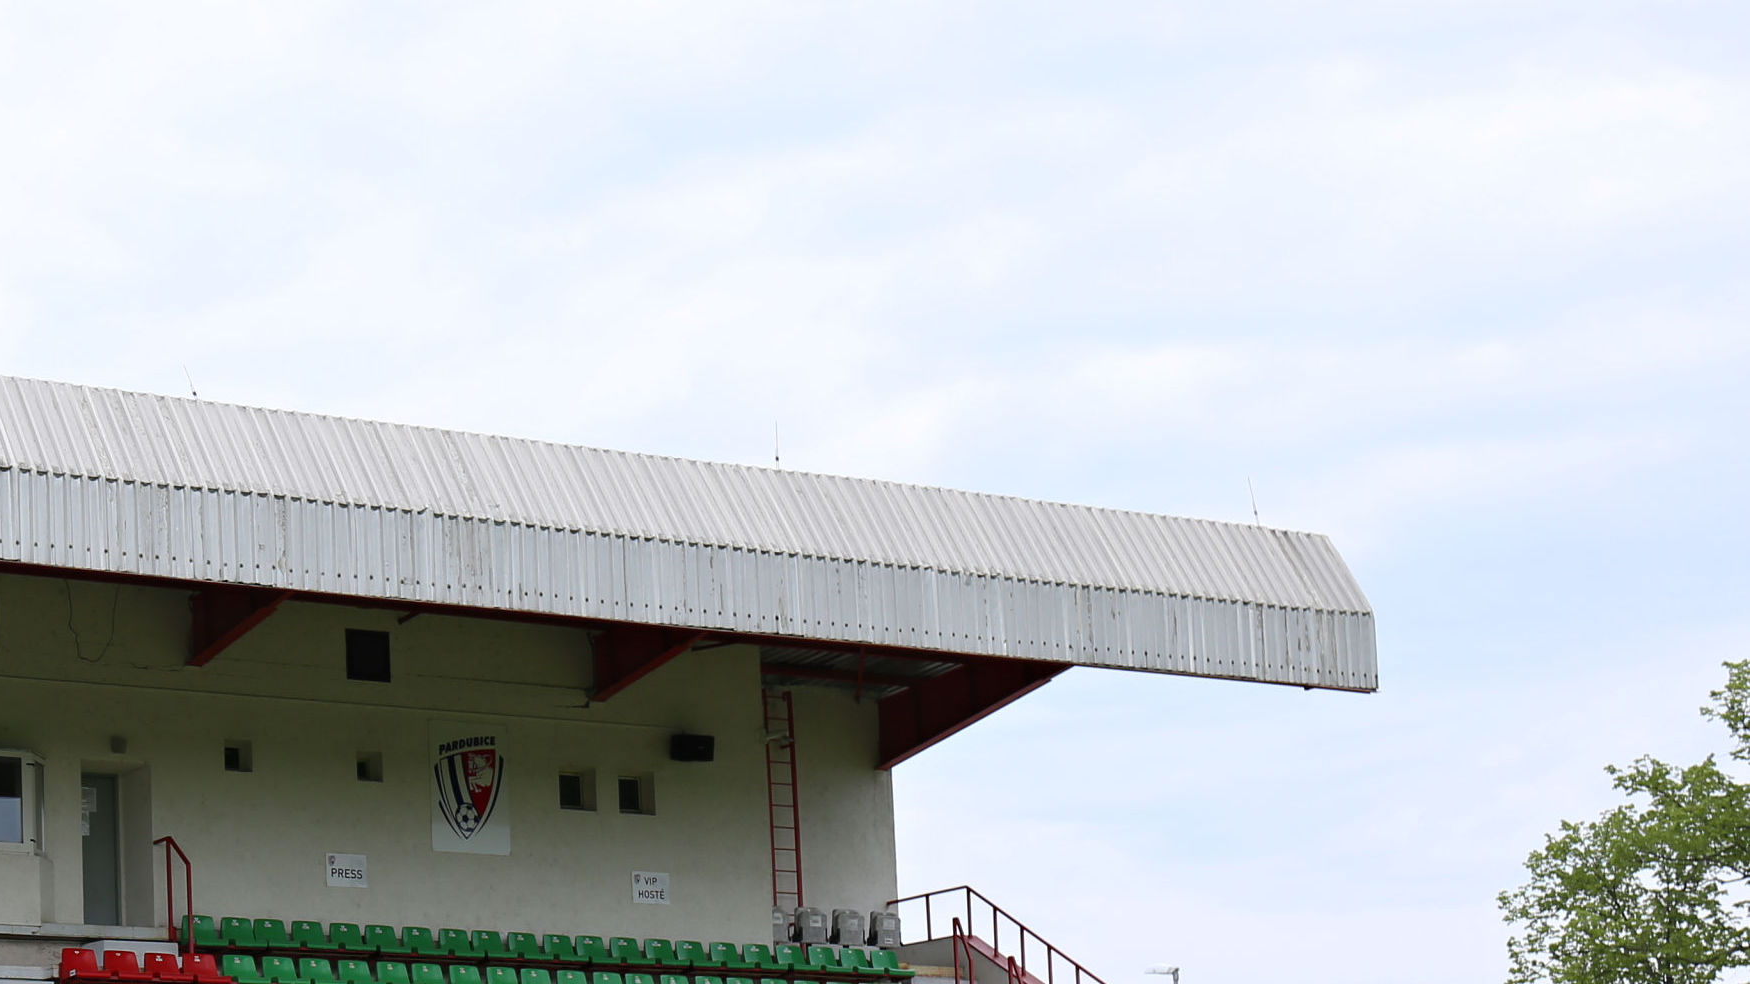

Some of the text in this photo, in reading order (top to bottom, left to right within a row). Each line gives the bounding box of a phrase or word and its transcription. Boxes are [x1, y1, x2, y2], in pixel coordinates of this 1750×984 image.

[439, 736, 496, 756] PARDUBICE
[331, 867, 363, 880] PRESS
[644, 876, 658, 886] VIP
[638, 888, 666, 900] HOSTÉ
